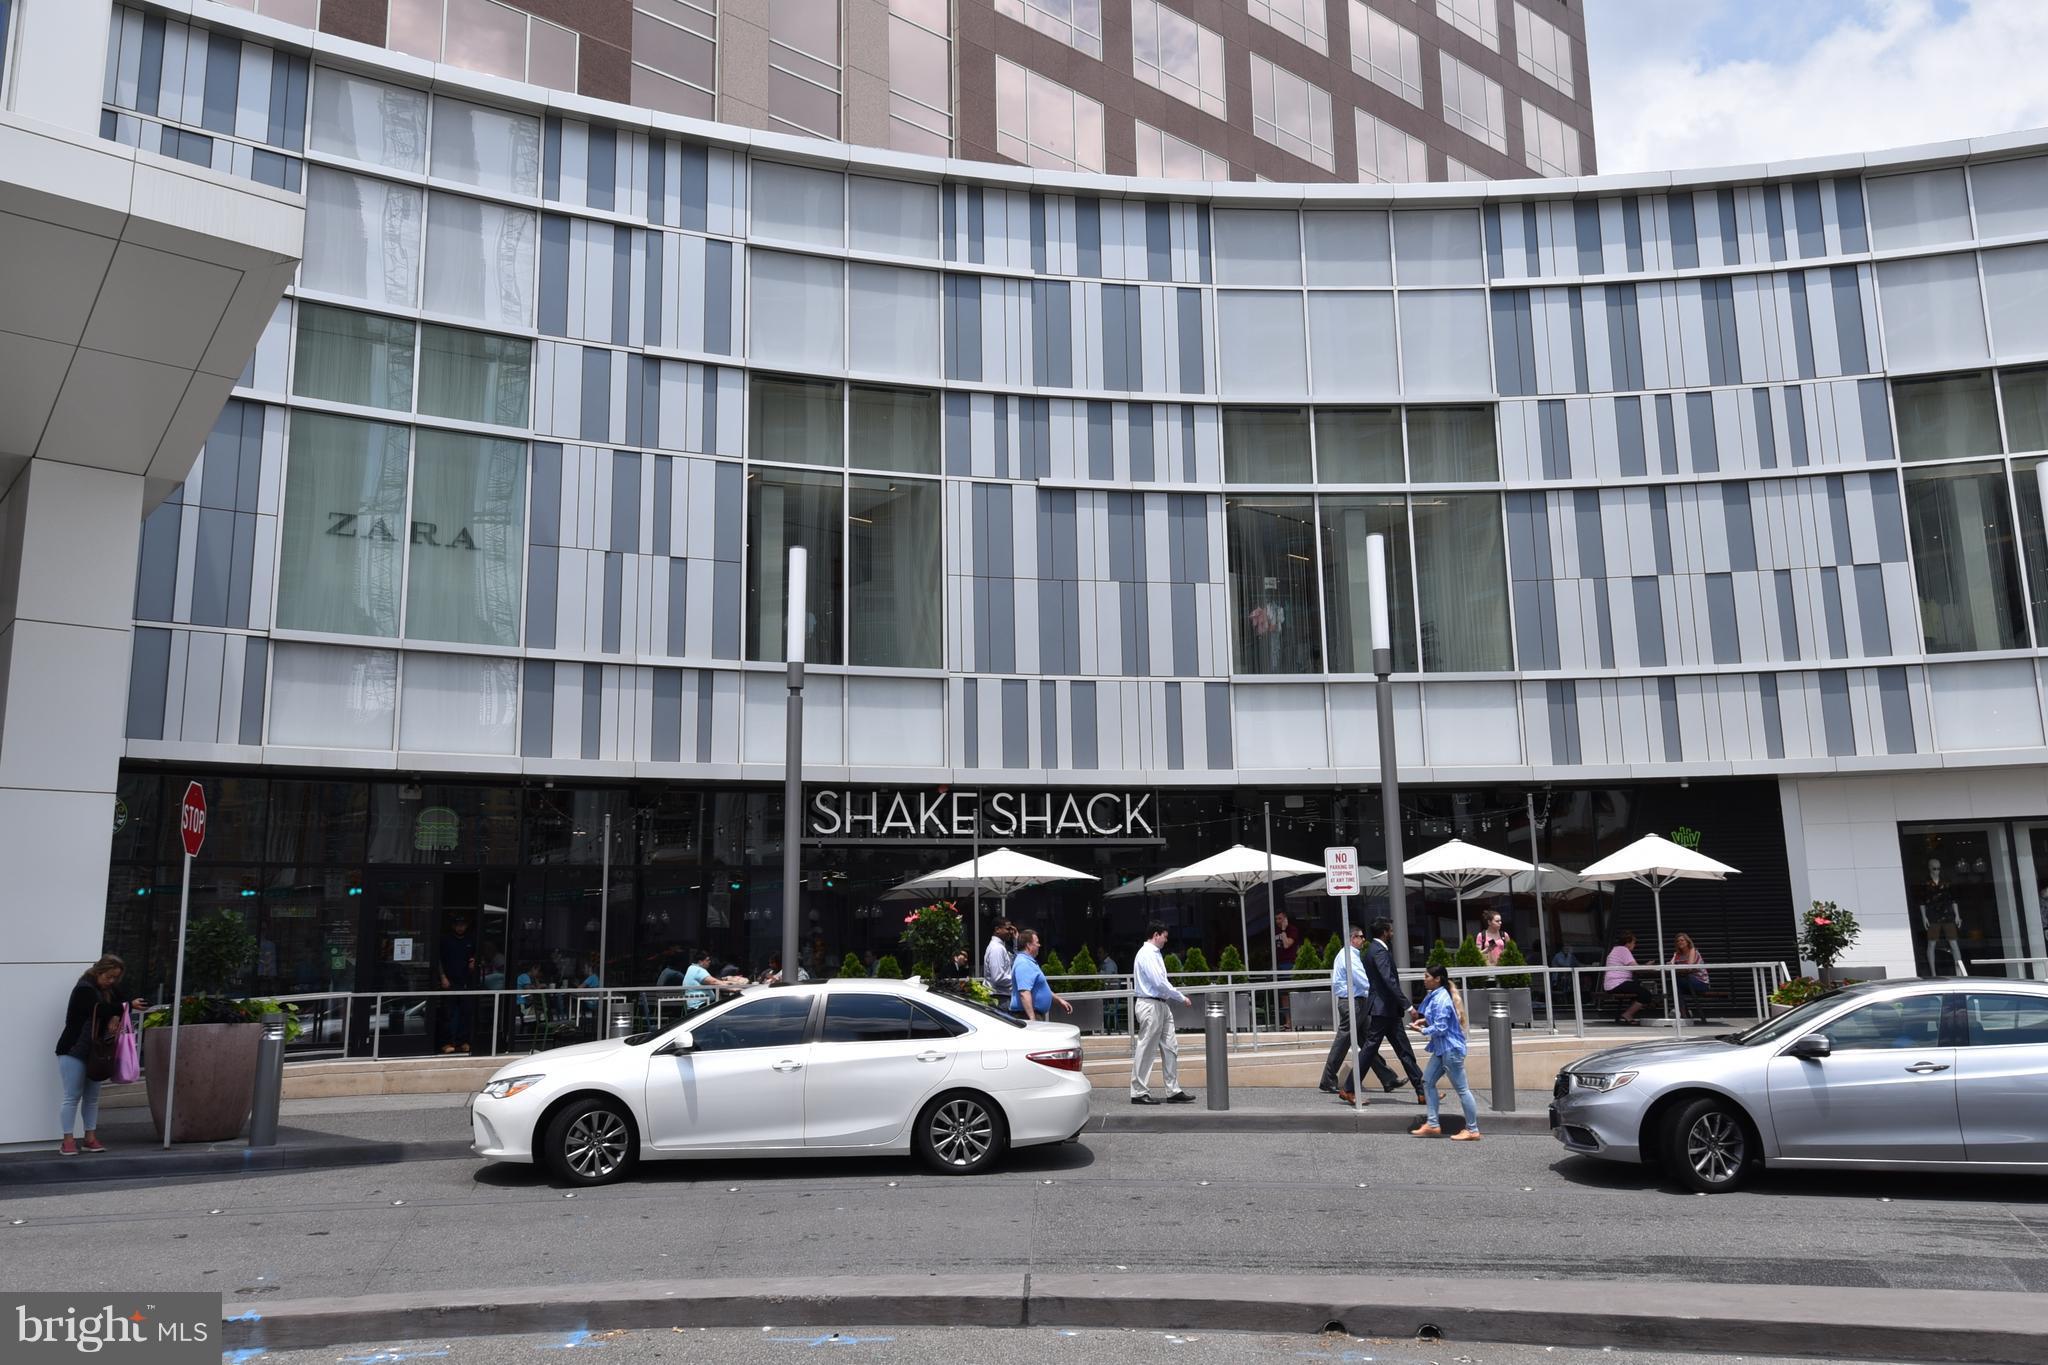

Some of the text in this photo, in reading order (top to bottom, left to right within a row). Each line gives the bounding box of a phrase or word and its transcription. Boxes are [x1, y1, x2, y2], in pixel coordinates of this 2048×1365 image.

[325, 511, 482, 551] ZARA
[183, 804, 204, 833] STOP
[813, 790, 1153, 834] SHAKE SHACK
[1335, 852, 1347, 863] NO
